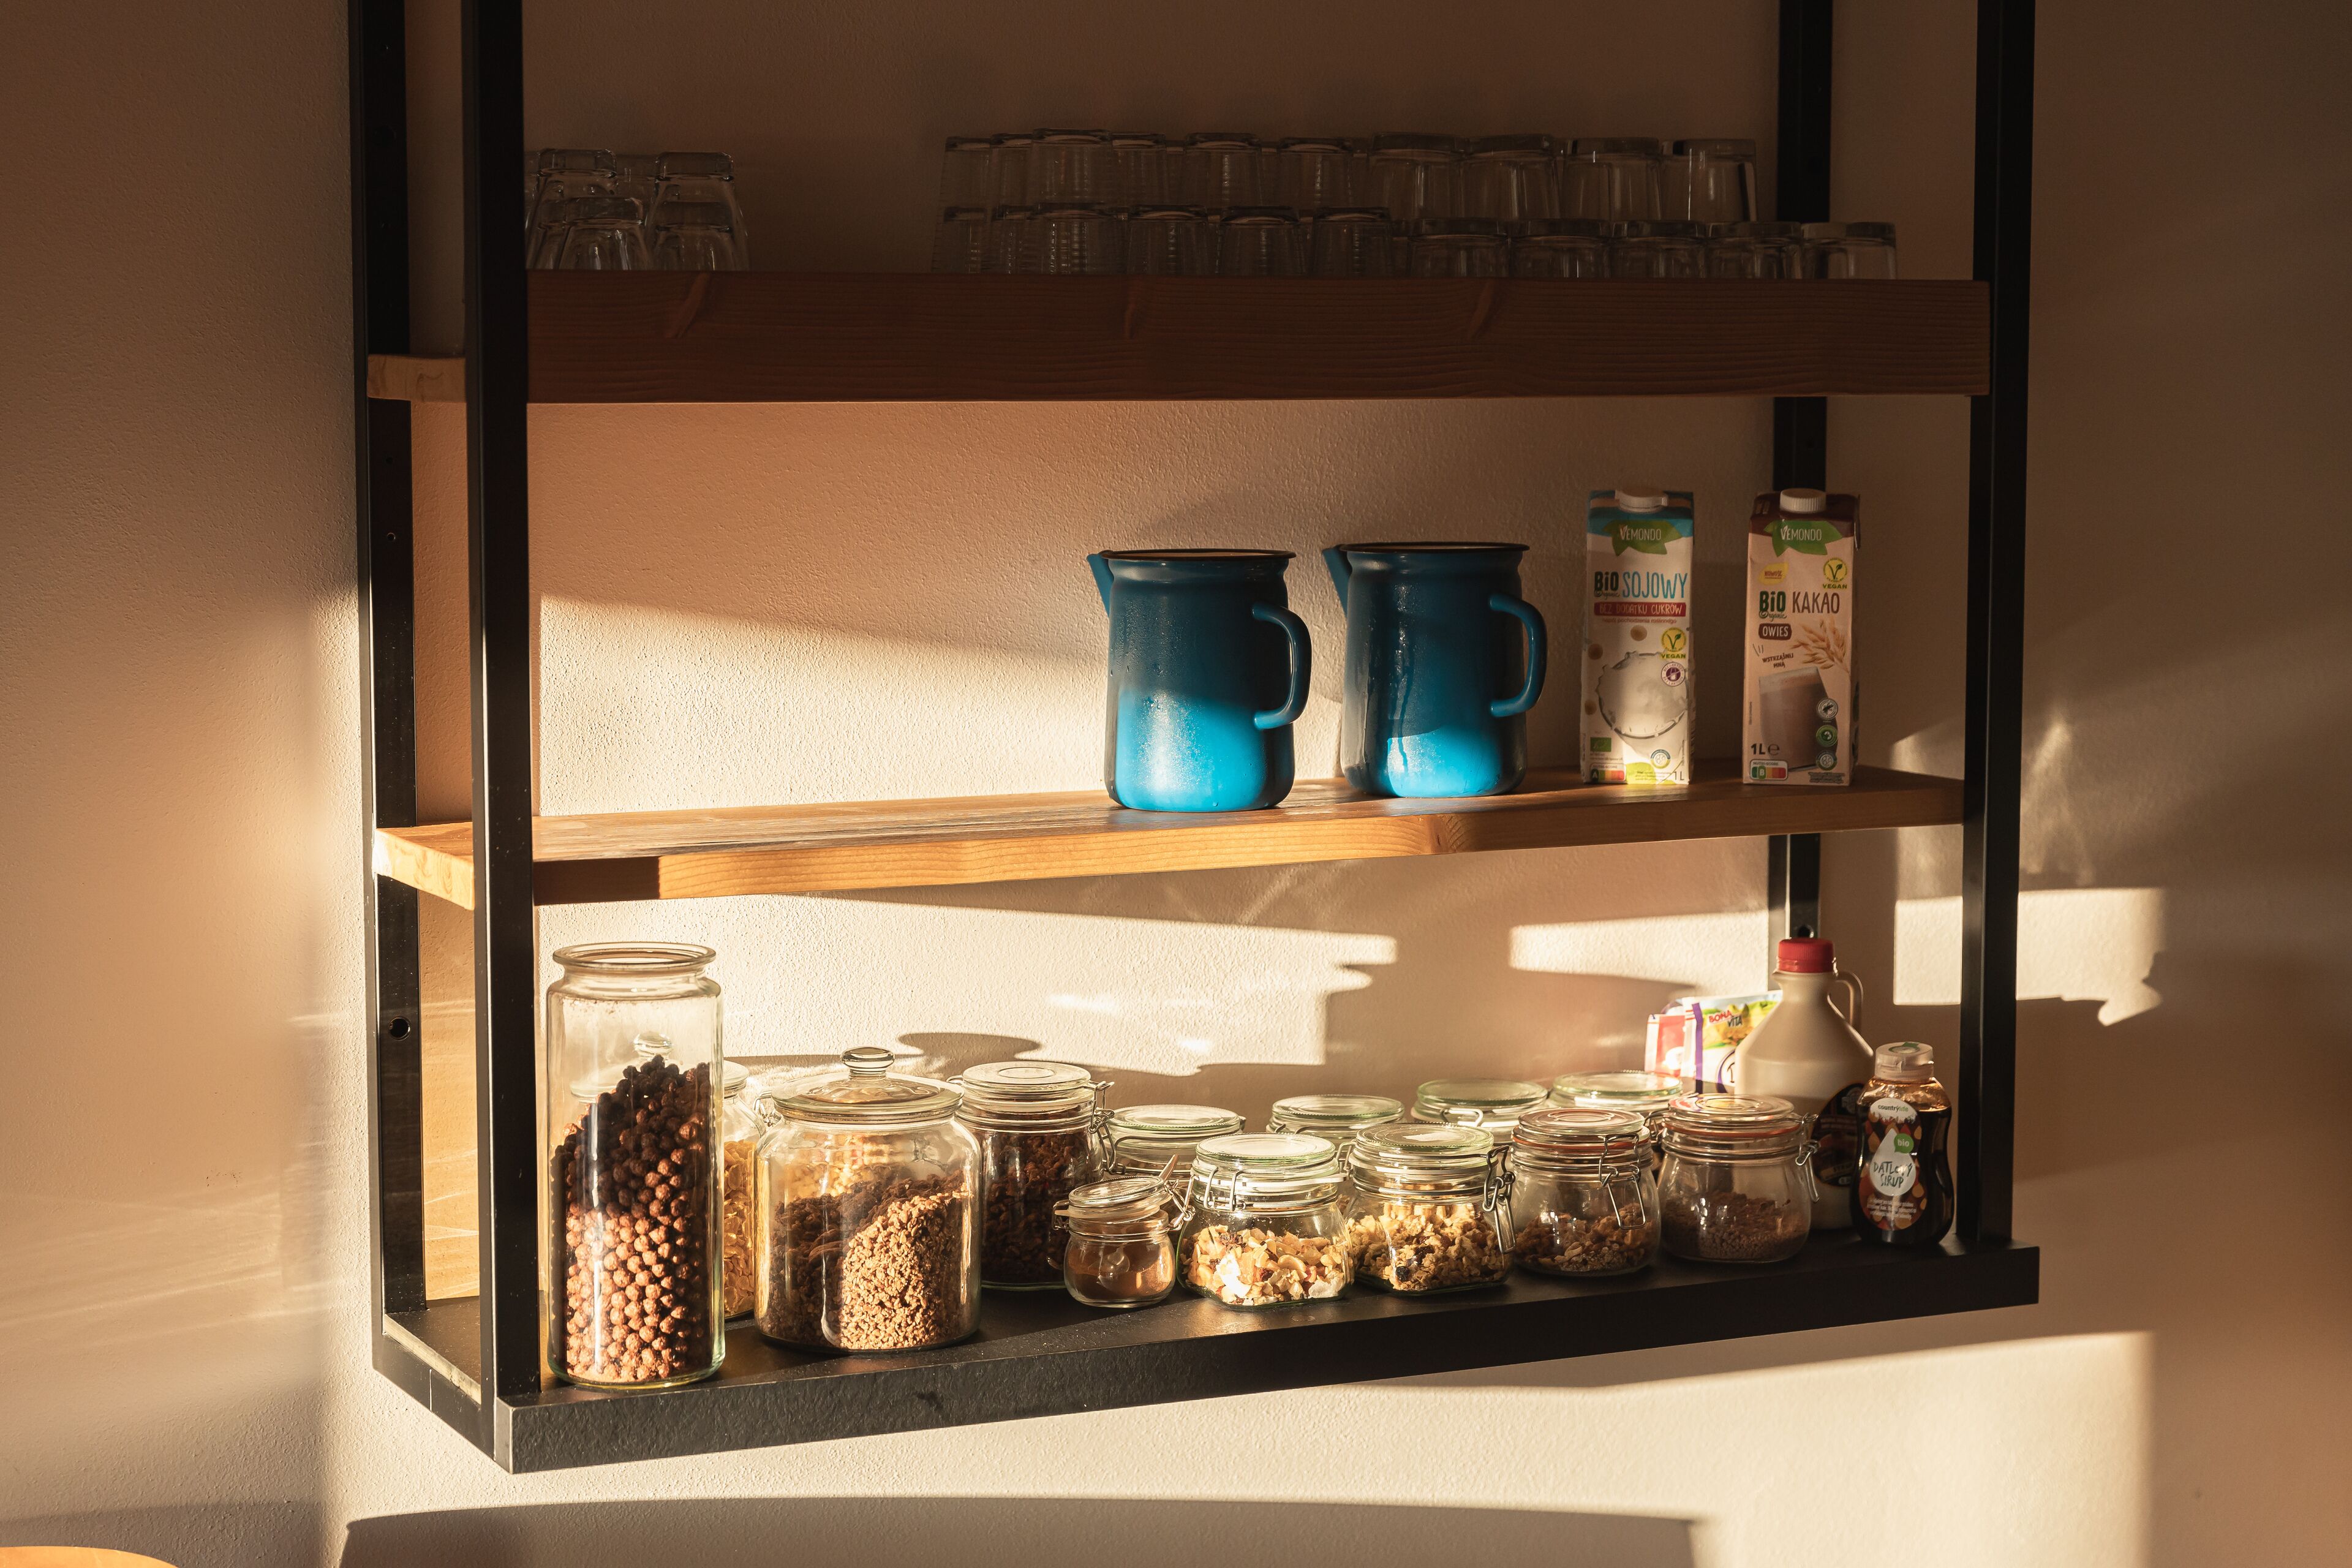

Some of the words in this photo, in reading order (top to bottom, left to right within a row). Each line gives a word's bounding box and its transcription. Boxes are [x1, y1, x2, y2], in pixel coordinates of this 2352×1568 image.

[1619, 524, 1662, 540] VEMONDO
[1781, 525, 1822, 541] VEMONDO
[1623, 571, 1688, 599] SOJOWY
[1599, 603, 1612, 614] BEZ
[1616, 603, 1648, 614] DODATKU
[1651, 602, 1683, 615] CUKRÓW
[1792, 591, 1840, 614] KAKAO
[1758, 611, 1787, 622] Organic
[1762, 626, 1789, 637] OWIES
[1709, 1009, 1733, 1023] BONA
[1727, 1014, 1743, 1028] VITA
[1897, 1139, 1910, 1147] bio
[1873, 1161, 1913, 1177] DATLOÝ
[1880, 1174, 1904, 1188] SIRUP
